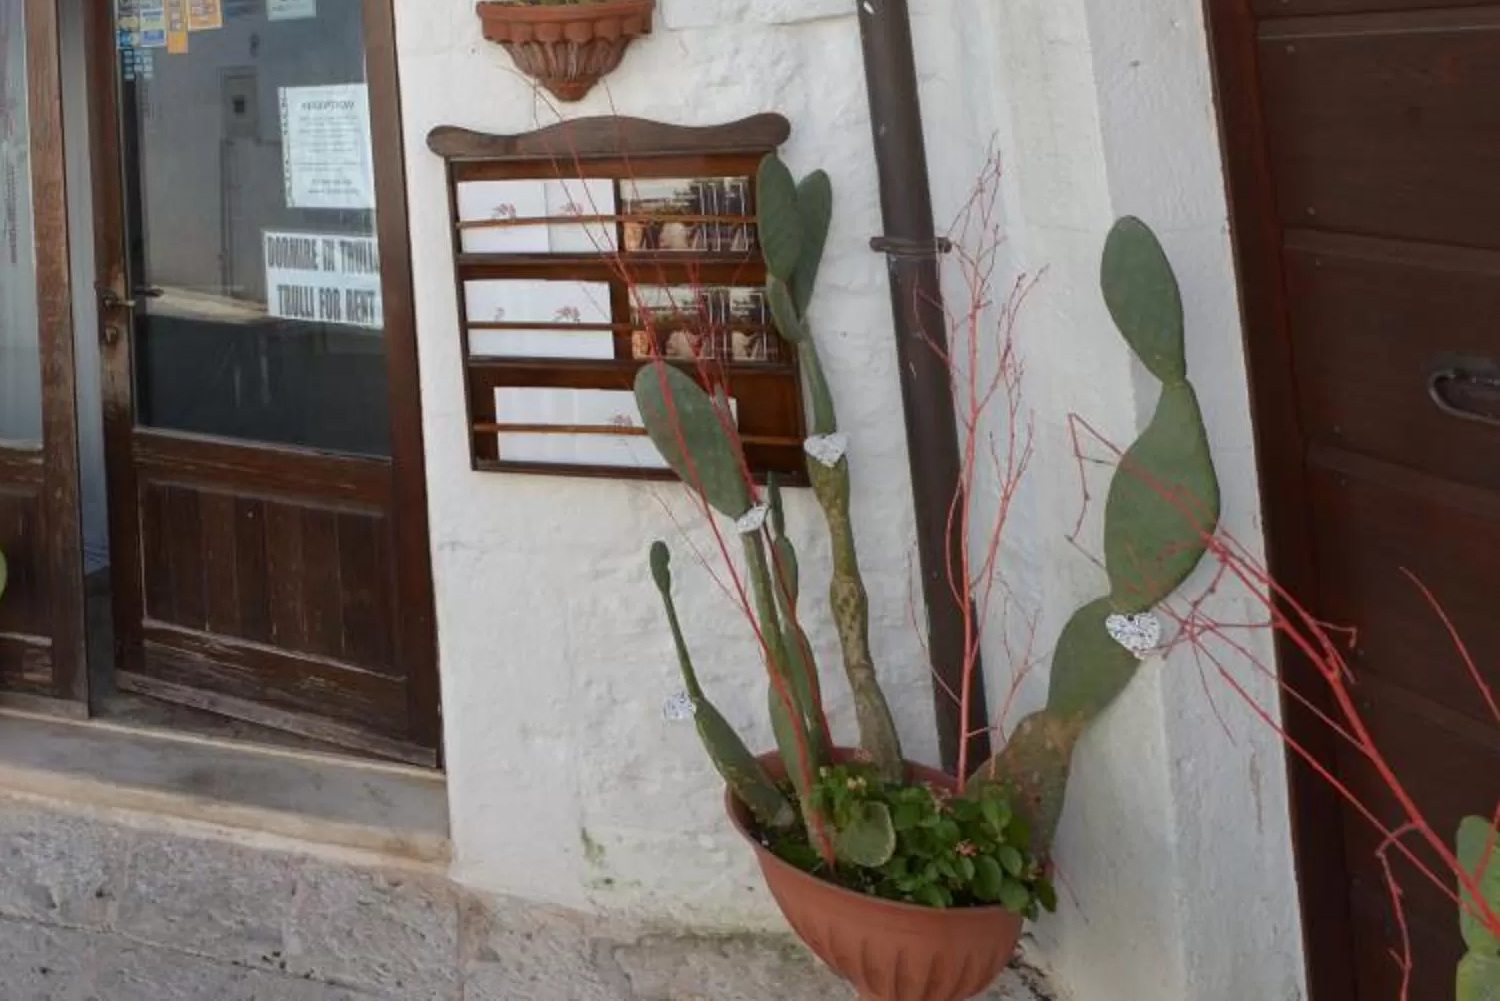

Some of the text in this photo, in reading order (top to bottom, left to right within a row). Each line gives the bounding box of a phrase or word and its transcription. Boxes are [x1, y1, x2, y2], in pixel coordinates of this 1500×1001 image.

[276, 284, 376, 324] TRULLI FOR RENT
